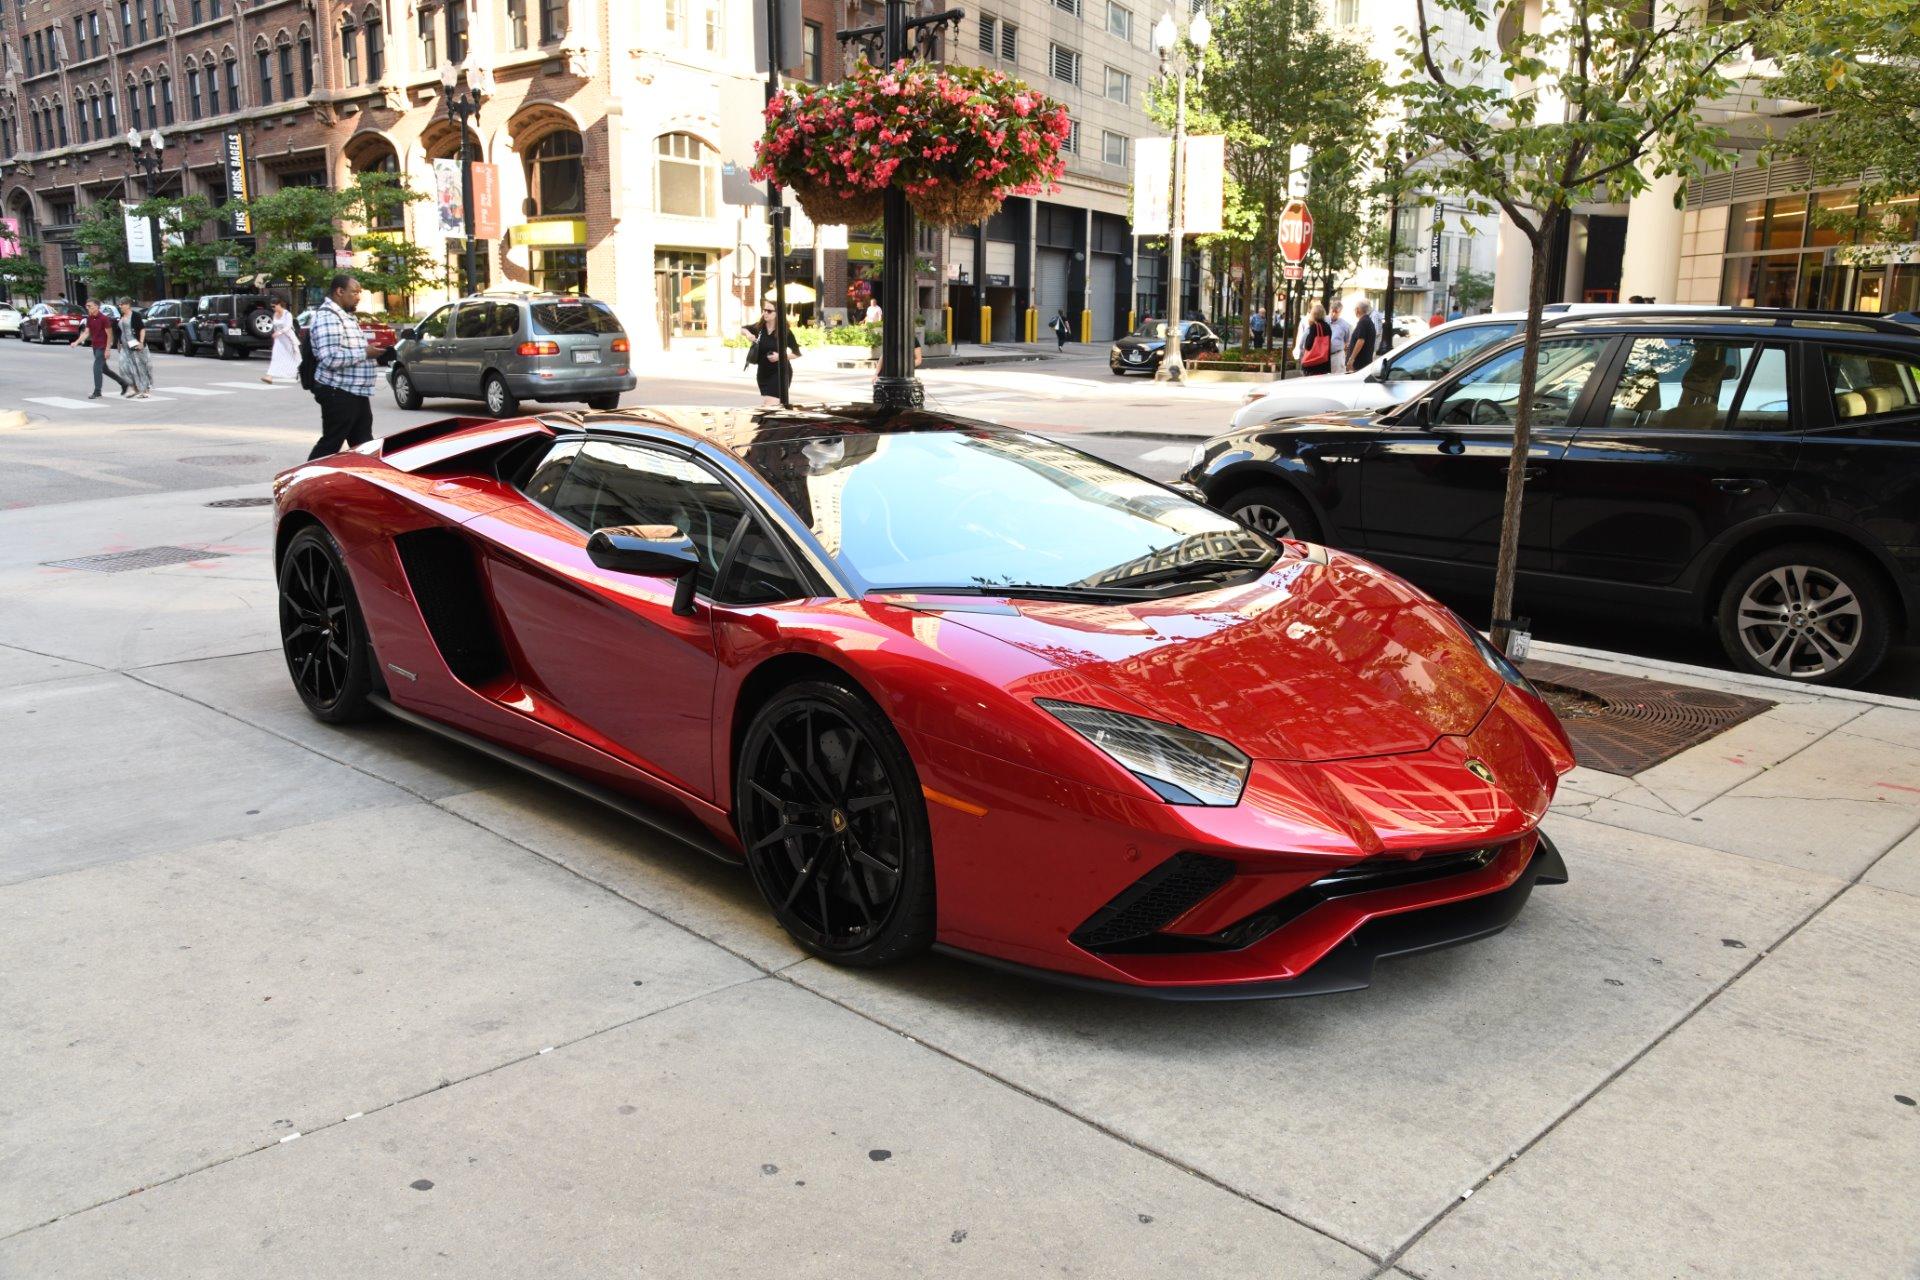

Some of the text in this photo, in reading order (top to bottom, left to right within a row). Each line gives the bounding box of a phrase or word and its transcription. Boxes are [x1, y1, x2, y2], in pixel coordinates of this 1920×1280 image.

[228, 134, 240, 167] BAGELS
[233, 194, 245, 231] EINSN
[1281, 221, 1311, 243] STOP
[1431, 247, 1439, 267] rack
